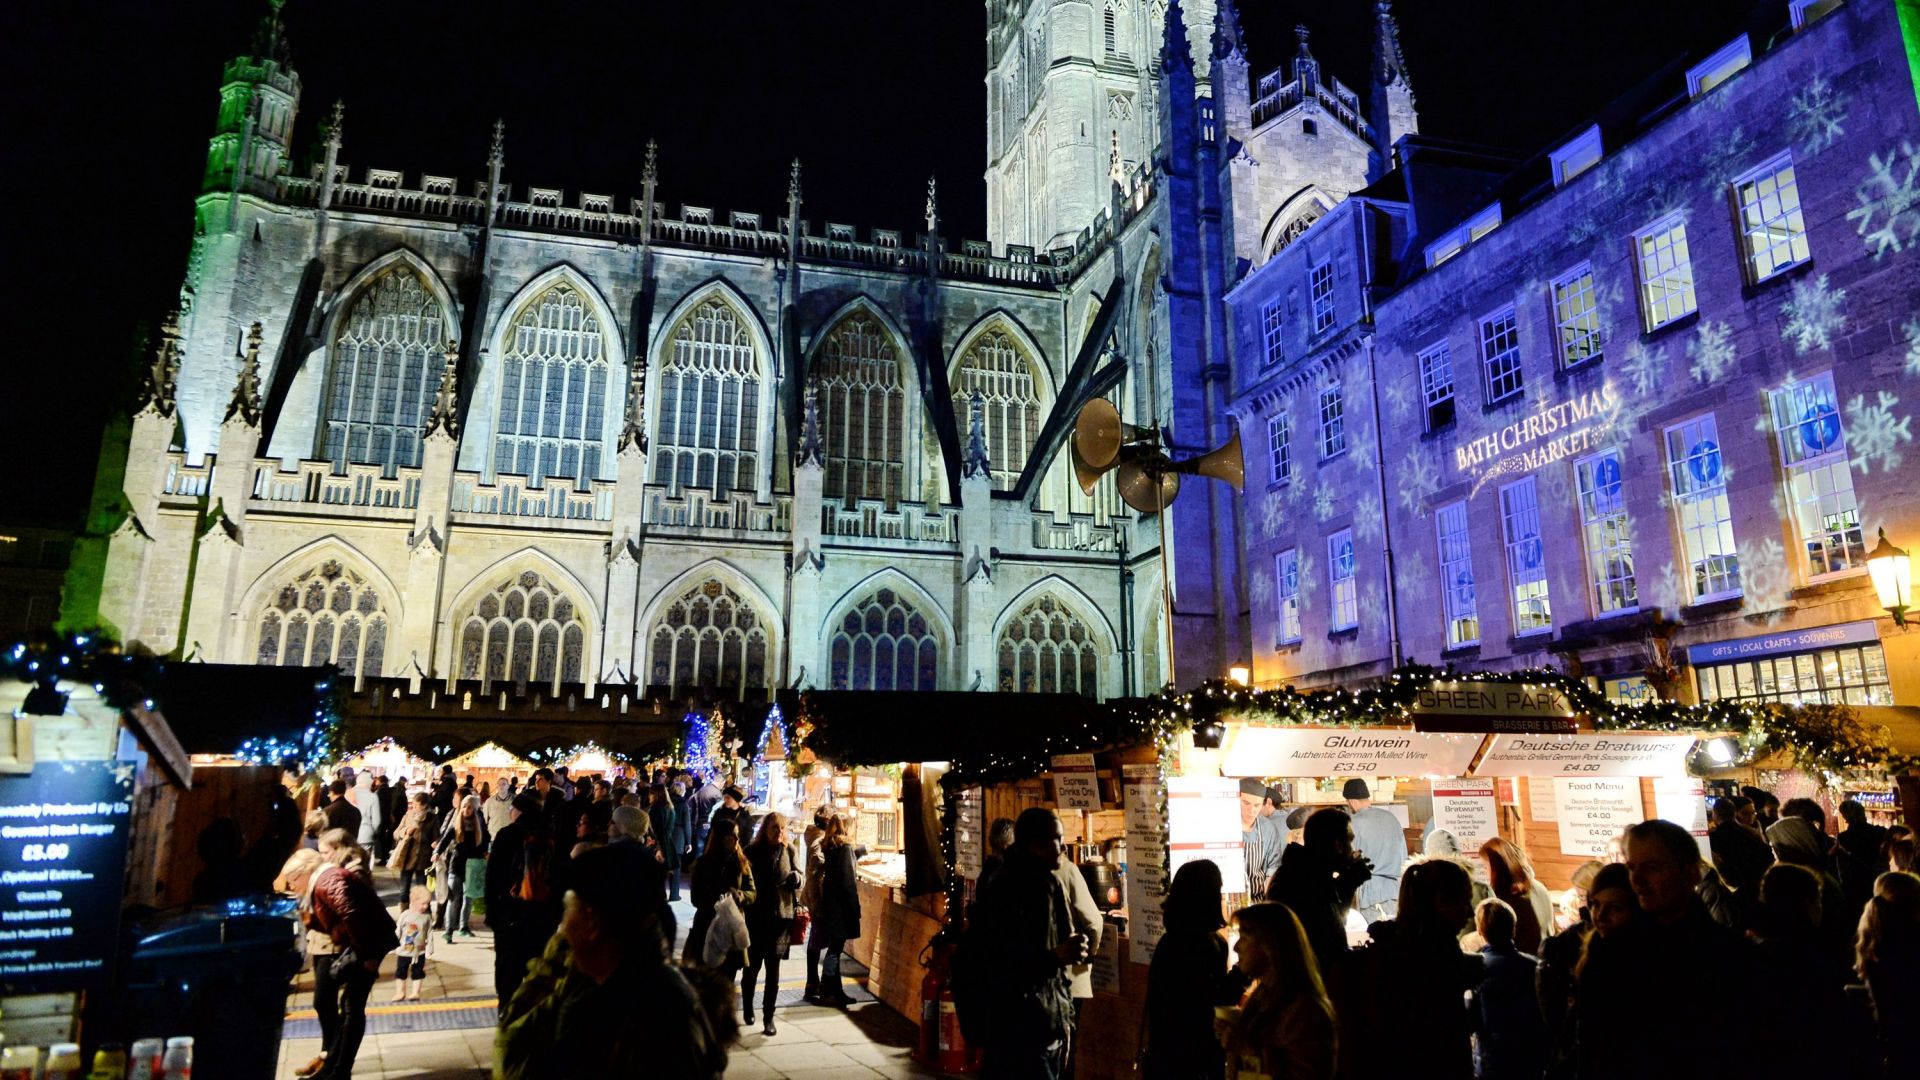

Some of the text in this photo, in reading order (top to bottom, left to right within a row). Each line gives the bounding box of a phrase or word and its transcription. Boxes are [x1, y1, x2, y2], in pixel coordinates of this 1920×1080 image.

[1456, 384, 1616, 472] BATH CHRISTMAS
[1522, 427, 1592, 472] MARKET
[1712, 630, 1846, 656] GIFTS LOCAL CRAFTS SOUVENIRS
[1419, 690, 1565, 711] GREEN PARK
[1492, 719, 1542, 731] BRASSERIE
[1552, 720, 1570, 731] BAR
[1324, 735, 1411, 748] Gluhwein
[1508, 739, 1679, 752] Deutsche Bratwurst
[1290, 750, 1429, 760] Authentic German Mulled Wine
[1489, 752, 1527, 761] Authentic
[1527, 753, 1552, 761] Grilled
[1552, 753, 1582, 761] German
[1582, 753, 1601, 761] Pork
[1601, 753, 1630, 762] Sausage
[1332, 762, 1377, 772] £3.50
[1562, 763, 1601, 772] £4.00
[1063, 777, 1089, 786] Express
[1433, 780, 1491, 788] GREEN PARK
[1568, 782, 1624, 790] Food Menu
[1059, 787, 1095, 798] Drinks Only
[1069, 798, 1090, 807] Queue
[42, 802, 97, 816] Produced
[97, 803, 113, 815] By
[113, 802, 128, 813] Us
[1444, 805, 1485, 813] Bratwurst
[80, 823, 115, 836] Burger
